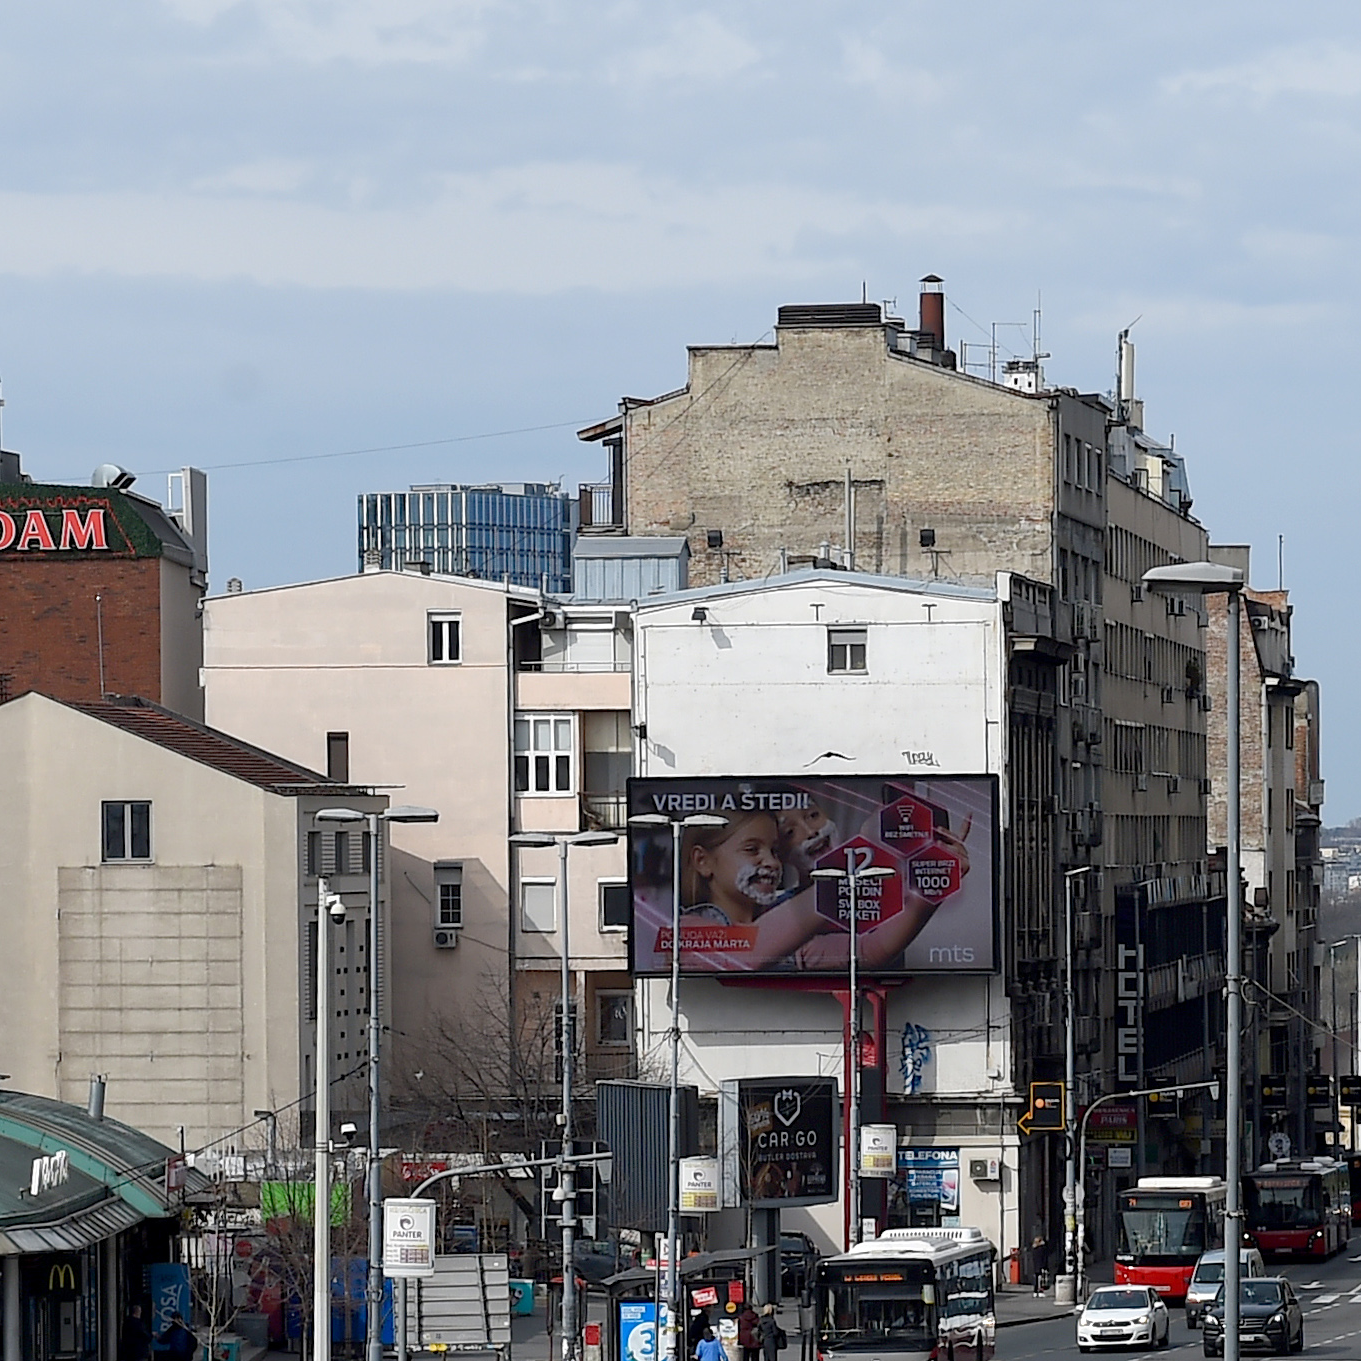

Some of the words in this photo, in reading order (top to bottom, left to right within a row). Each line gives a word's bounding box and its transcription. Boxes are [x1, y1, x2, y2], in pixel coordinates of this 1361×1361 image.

[653, 793, 715, 811] VREDI
[721, 794, 737, 811] A
[740, 787, 810, 811] ŠTEDI!
[843, 847, 874, 876] 12
[914, 867, 952, 876] INTERNET
[916, 876, 951, 889] 1000
[857, 900, 880, 909] BOX
[678, 940, 720, 949] KRAJA
[721, 940, 751, 949] MARTA
[929, 944, 975, 962] mts
[1117, 943, 1144, 1082] HOTEL
[898, 1150, 958, 1161] TELEFONA
[392, 1230, 422, 1239] PANTER
